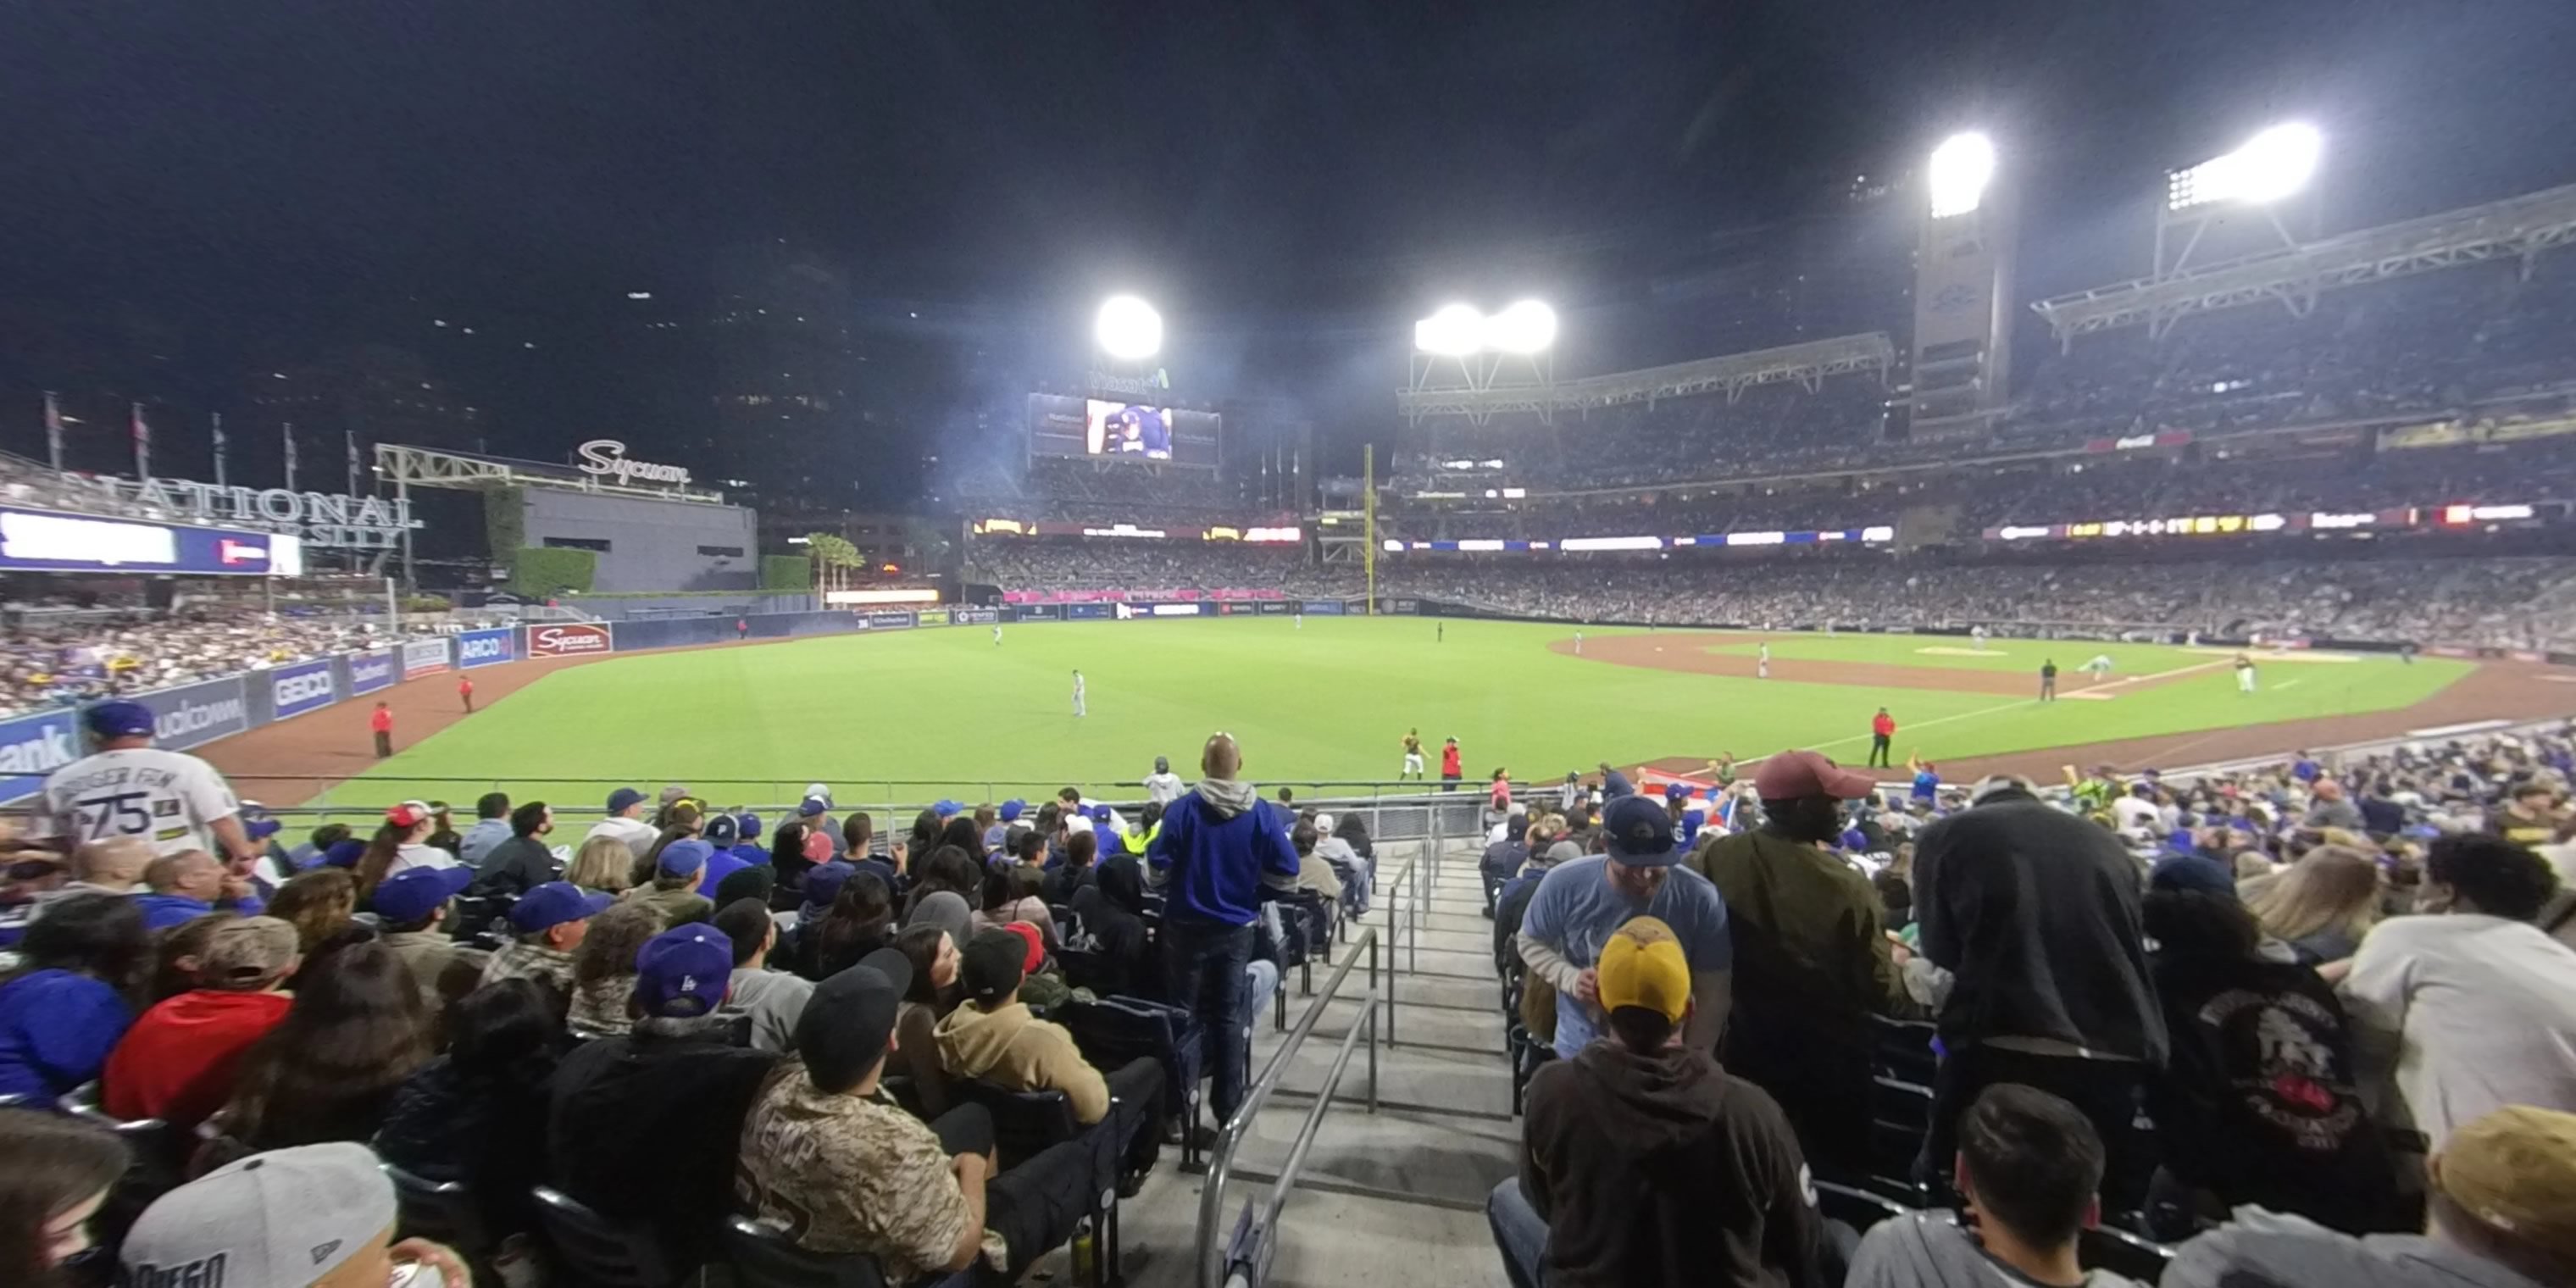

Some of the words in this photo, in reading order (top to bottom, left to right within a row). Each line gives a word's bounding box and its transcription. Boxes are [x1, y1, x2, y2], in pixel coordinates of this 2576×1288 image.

[578, 439, 692, 486] Sycuan
[462, 638, 499, 658] ARCO
[275, 669, 331, 707] GEICO
[155, 699, 240, 739] ualcomm
[0, 724, 72, 773] ank
